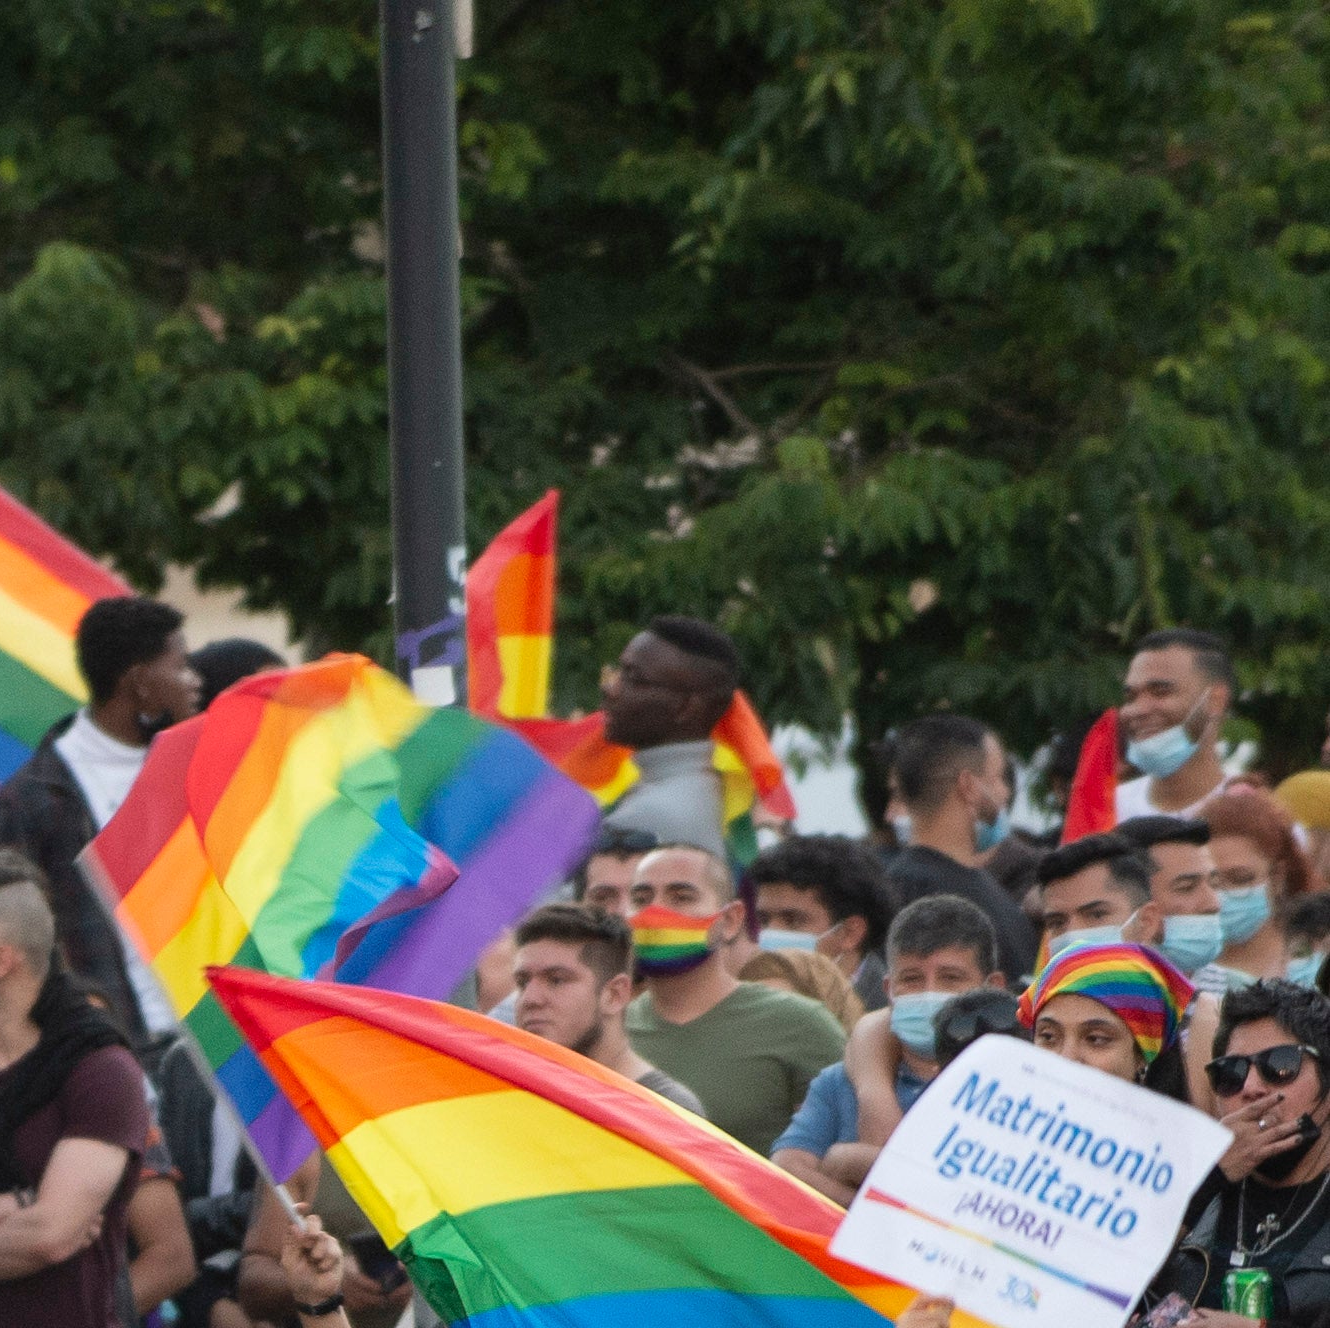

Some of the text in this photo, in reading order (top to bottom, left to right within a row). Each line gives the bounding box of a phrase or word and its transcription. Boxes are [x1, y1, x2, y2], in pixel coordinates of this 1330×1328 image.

[933, 1122, 1138, 1239] Igualitario
[951, 1070, 1174, 1194] Matrimonio
[953, 1190, 1065, 1248] ¡AHORA!
